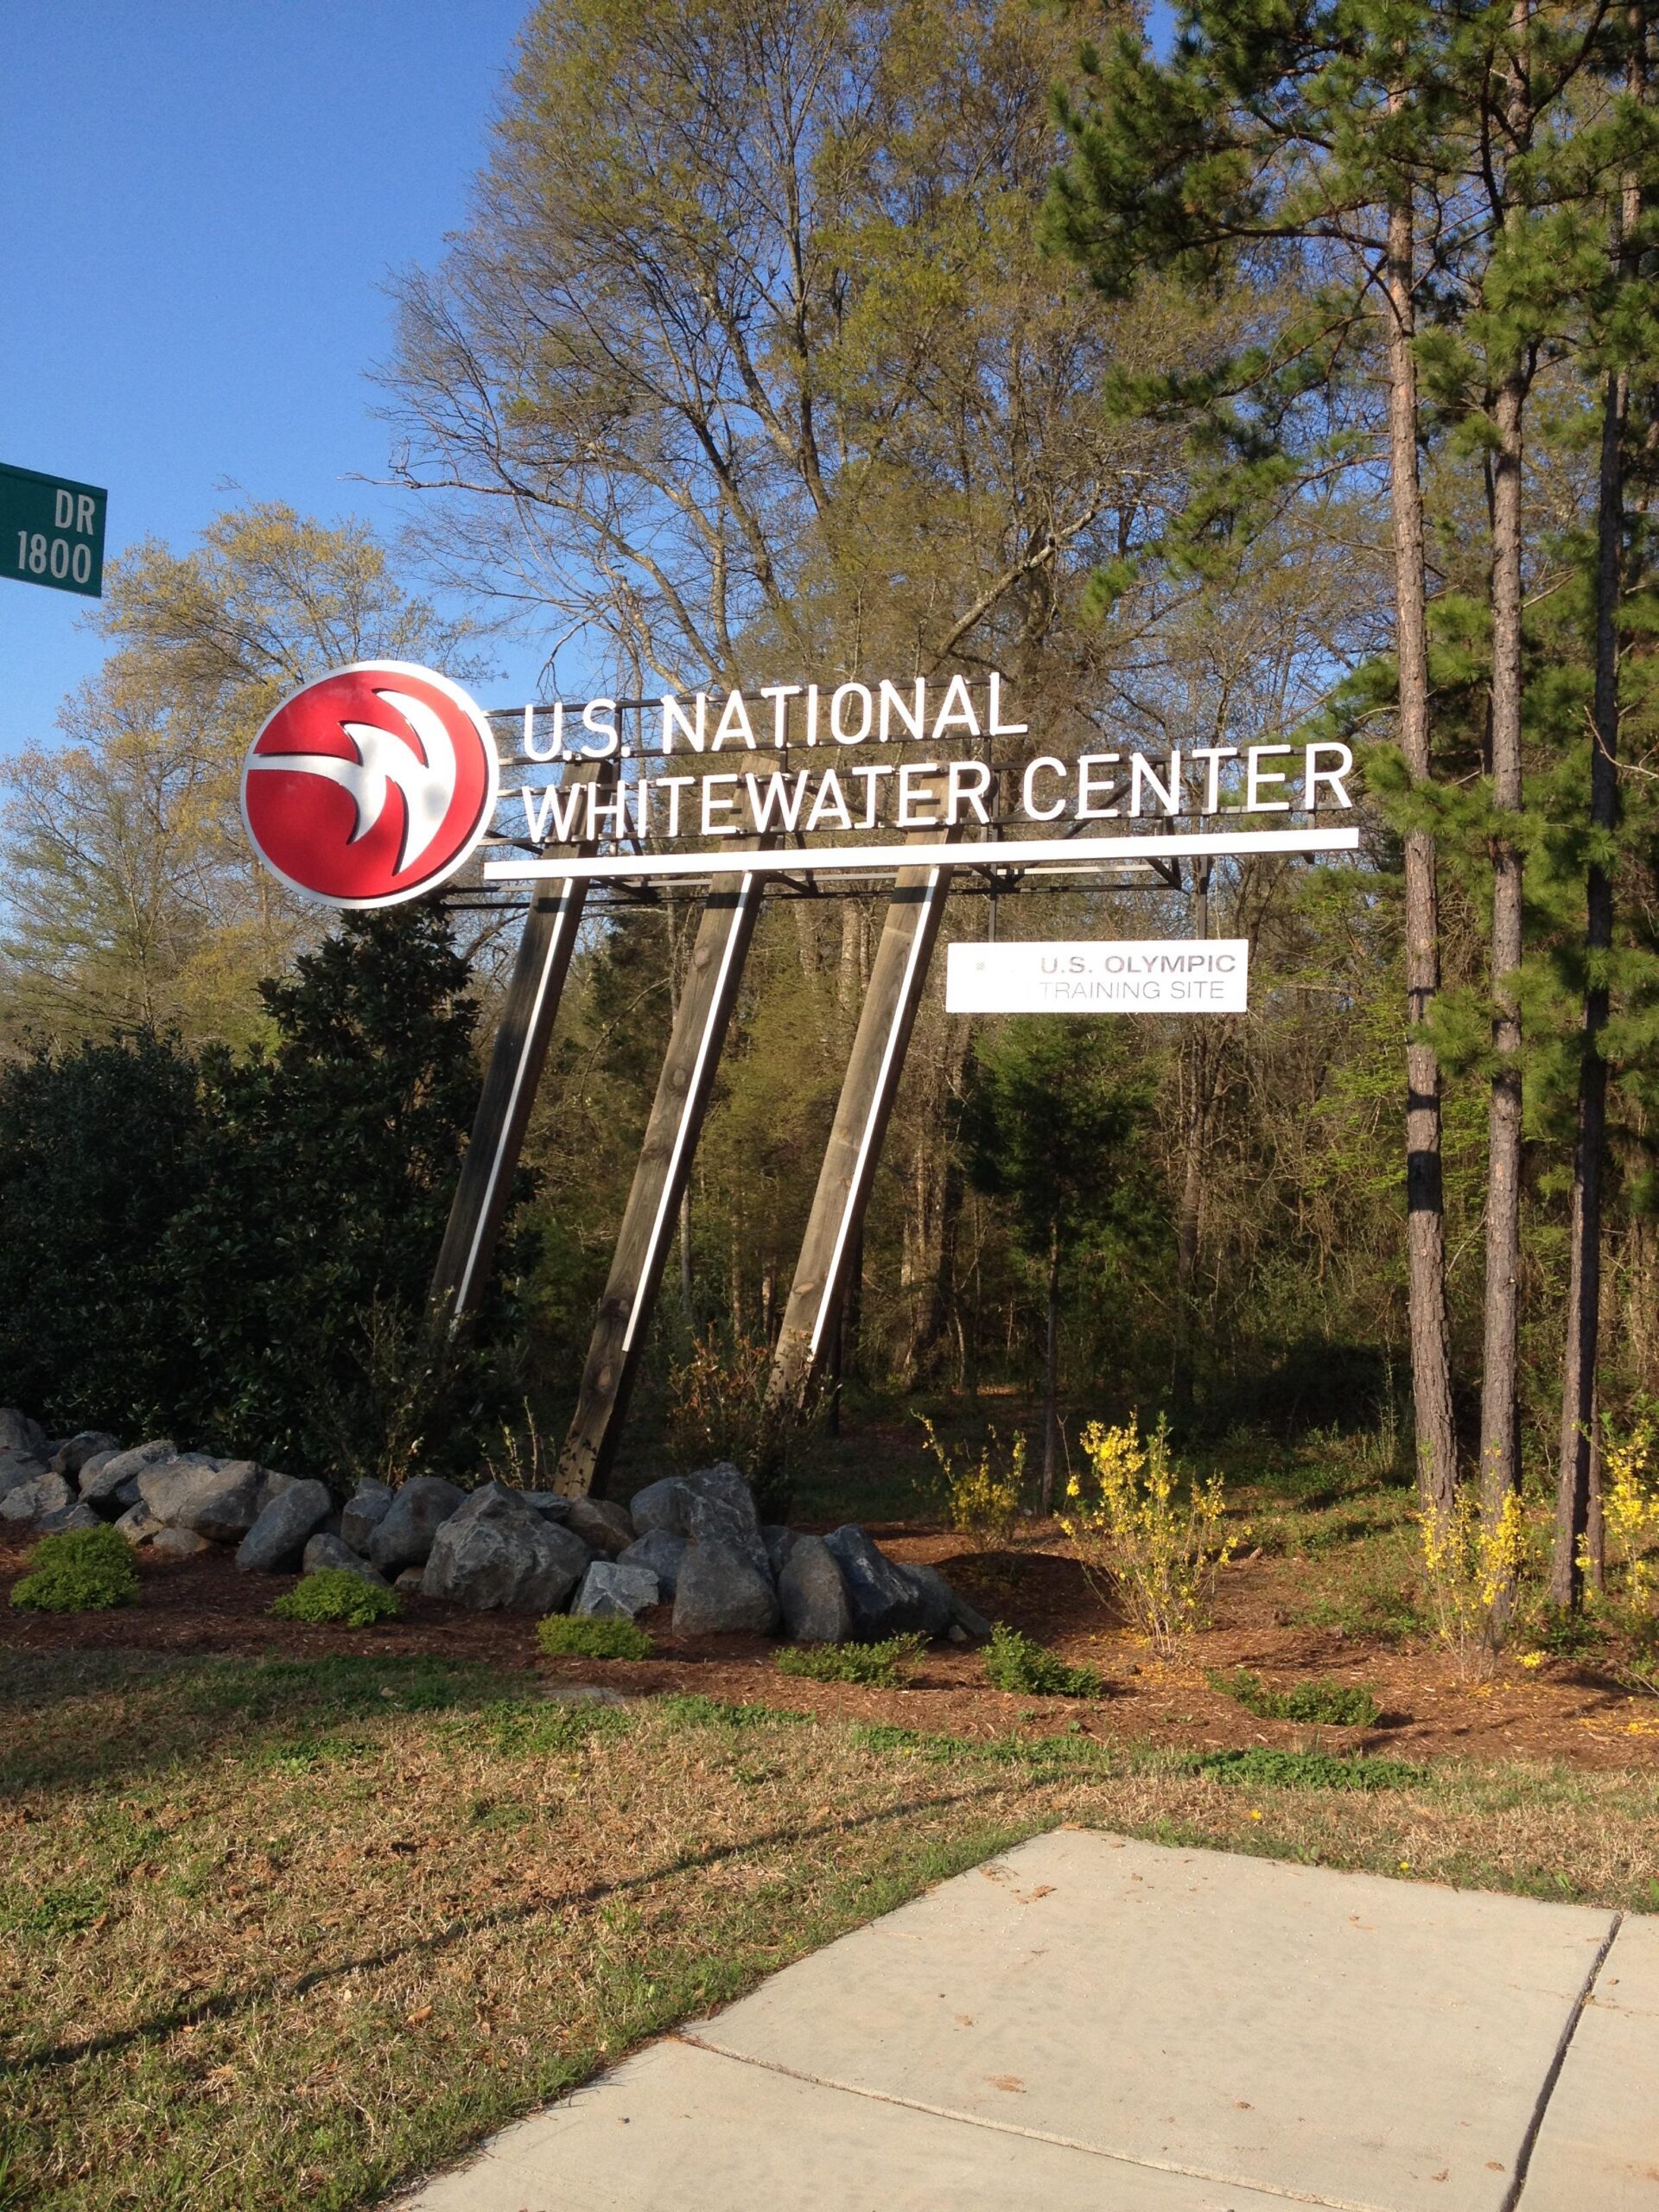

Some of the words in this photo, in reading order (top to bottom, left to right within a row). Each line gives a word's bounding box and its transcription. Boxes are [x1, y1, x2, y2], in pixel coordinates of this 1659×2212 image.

[54, 489, 95, 536] DR
[17, 531, 92, 584] 1800
[524, 698, 631, 761] U.S.
[661, 672, 1028, 754] NATIONAL
[521, 760, 991, 842] WHITEWATER
[1023, 741, 1353, 821] CENTER
[1040, 956, 1093, 974] U.S.
[1104, 955, 1236, 973] OLYMPIC
[1039, 981, 1160, 1000] TRAINING
[1170, 981, 1225, 999] SITE
